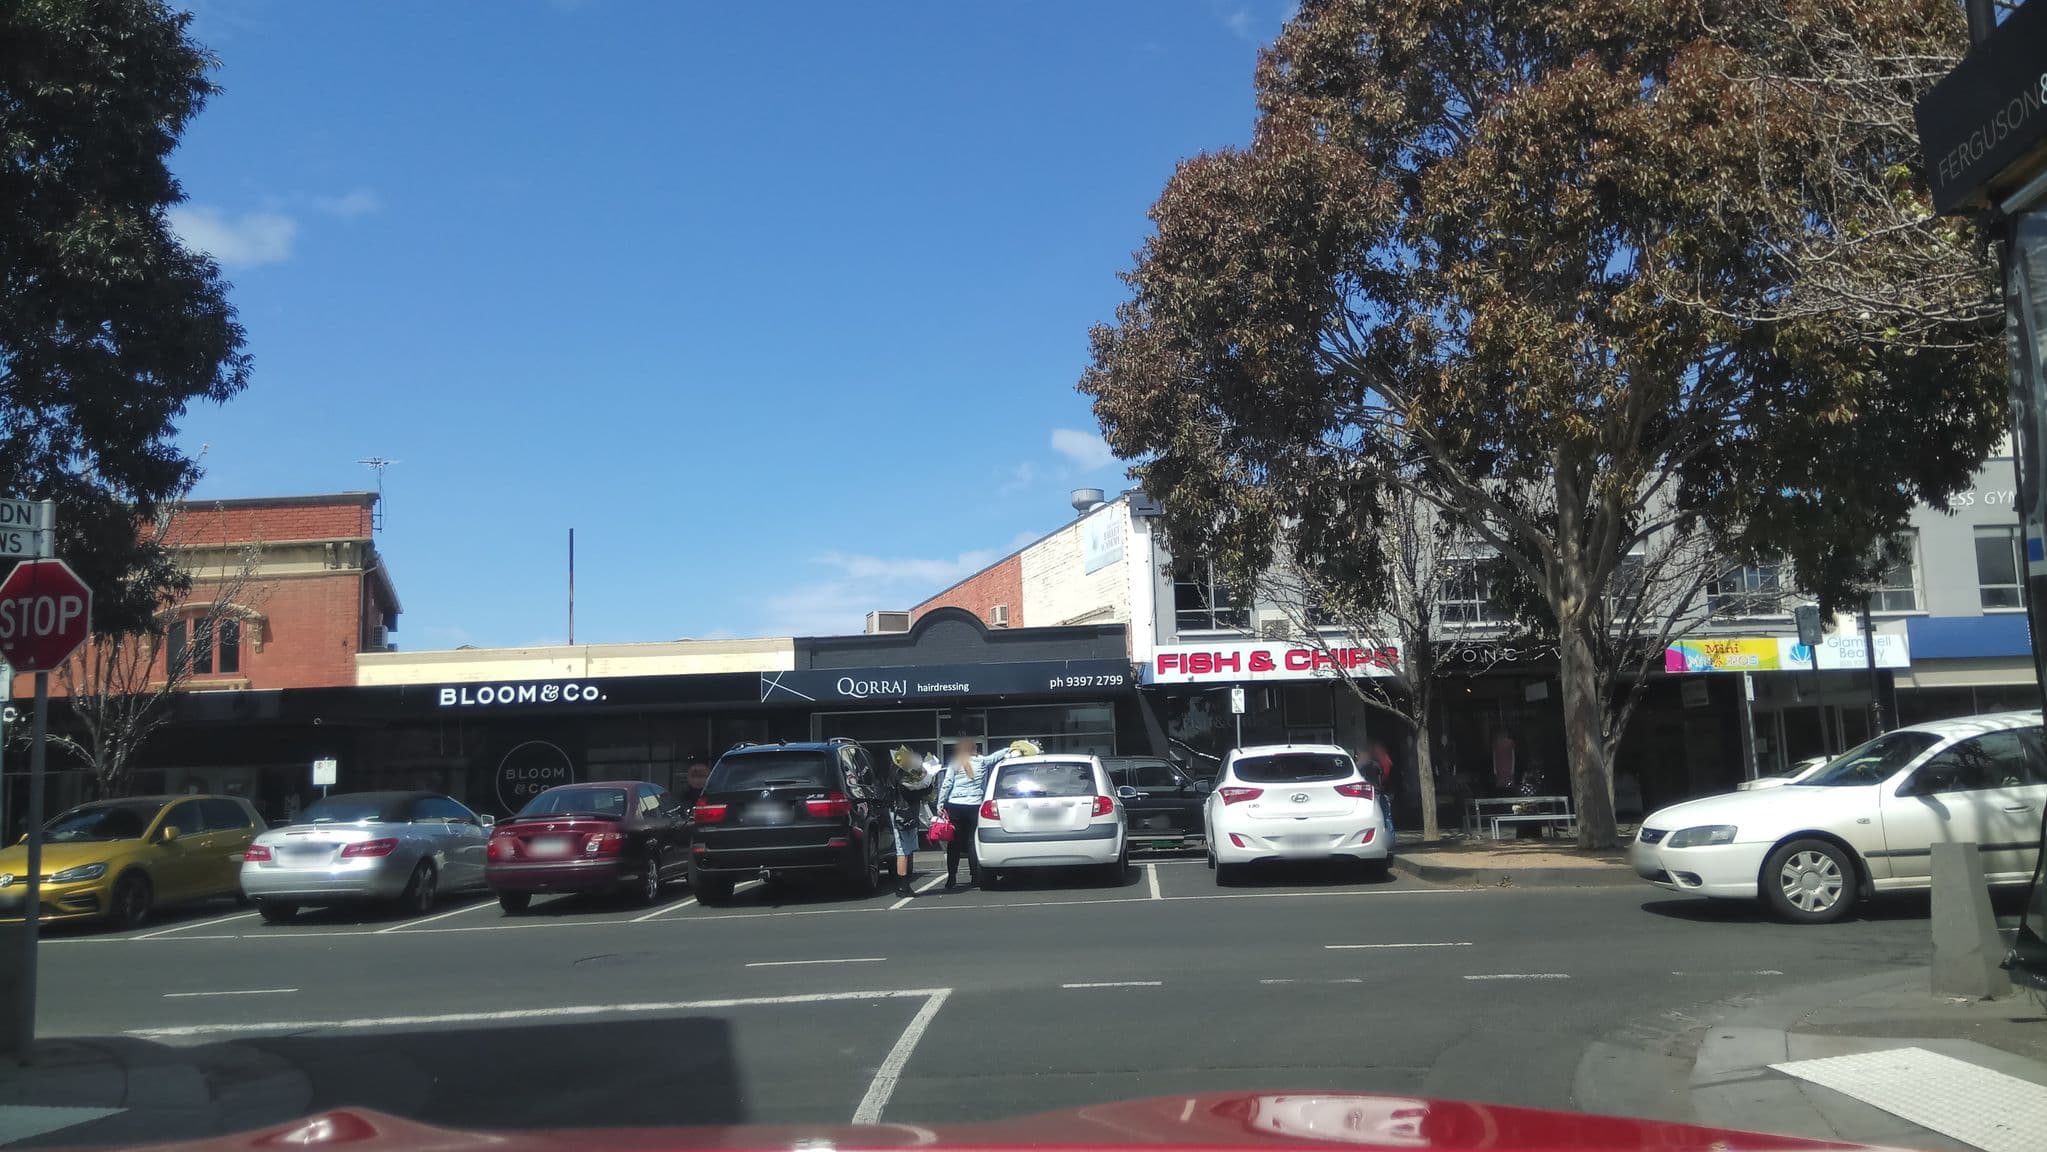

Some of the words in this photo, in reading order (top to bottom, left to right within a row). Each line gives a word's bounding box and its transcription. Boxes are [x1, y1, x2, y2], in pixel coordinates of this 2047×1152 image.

[0, 595, 83, 639] STOP
[1705, 644, 1739, 654] Mini
[1157, 651, 1241, 675] FISH
[1248, 650, 1276, 672] &
[1285, 646, 1399, 670] CHIPS
[917, 682, 970, 692] hairdressing
[1050, 677, 1064, 690] ph
[1066, 676, 1093, 687] 9397
[1096, 675, 1123, 686] 2799
[506, 768, 565, 780] BLOOM
